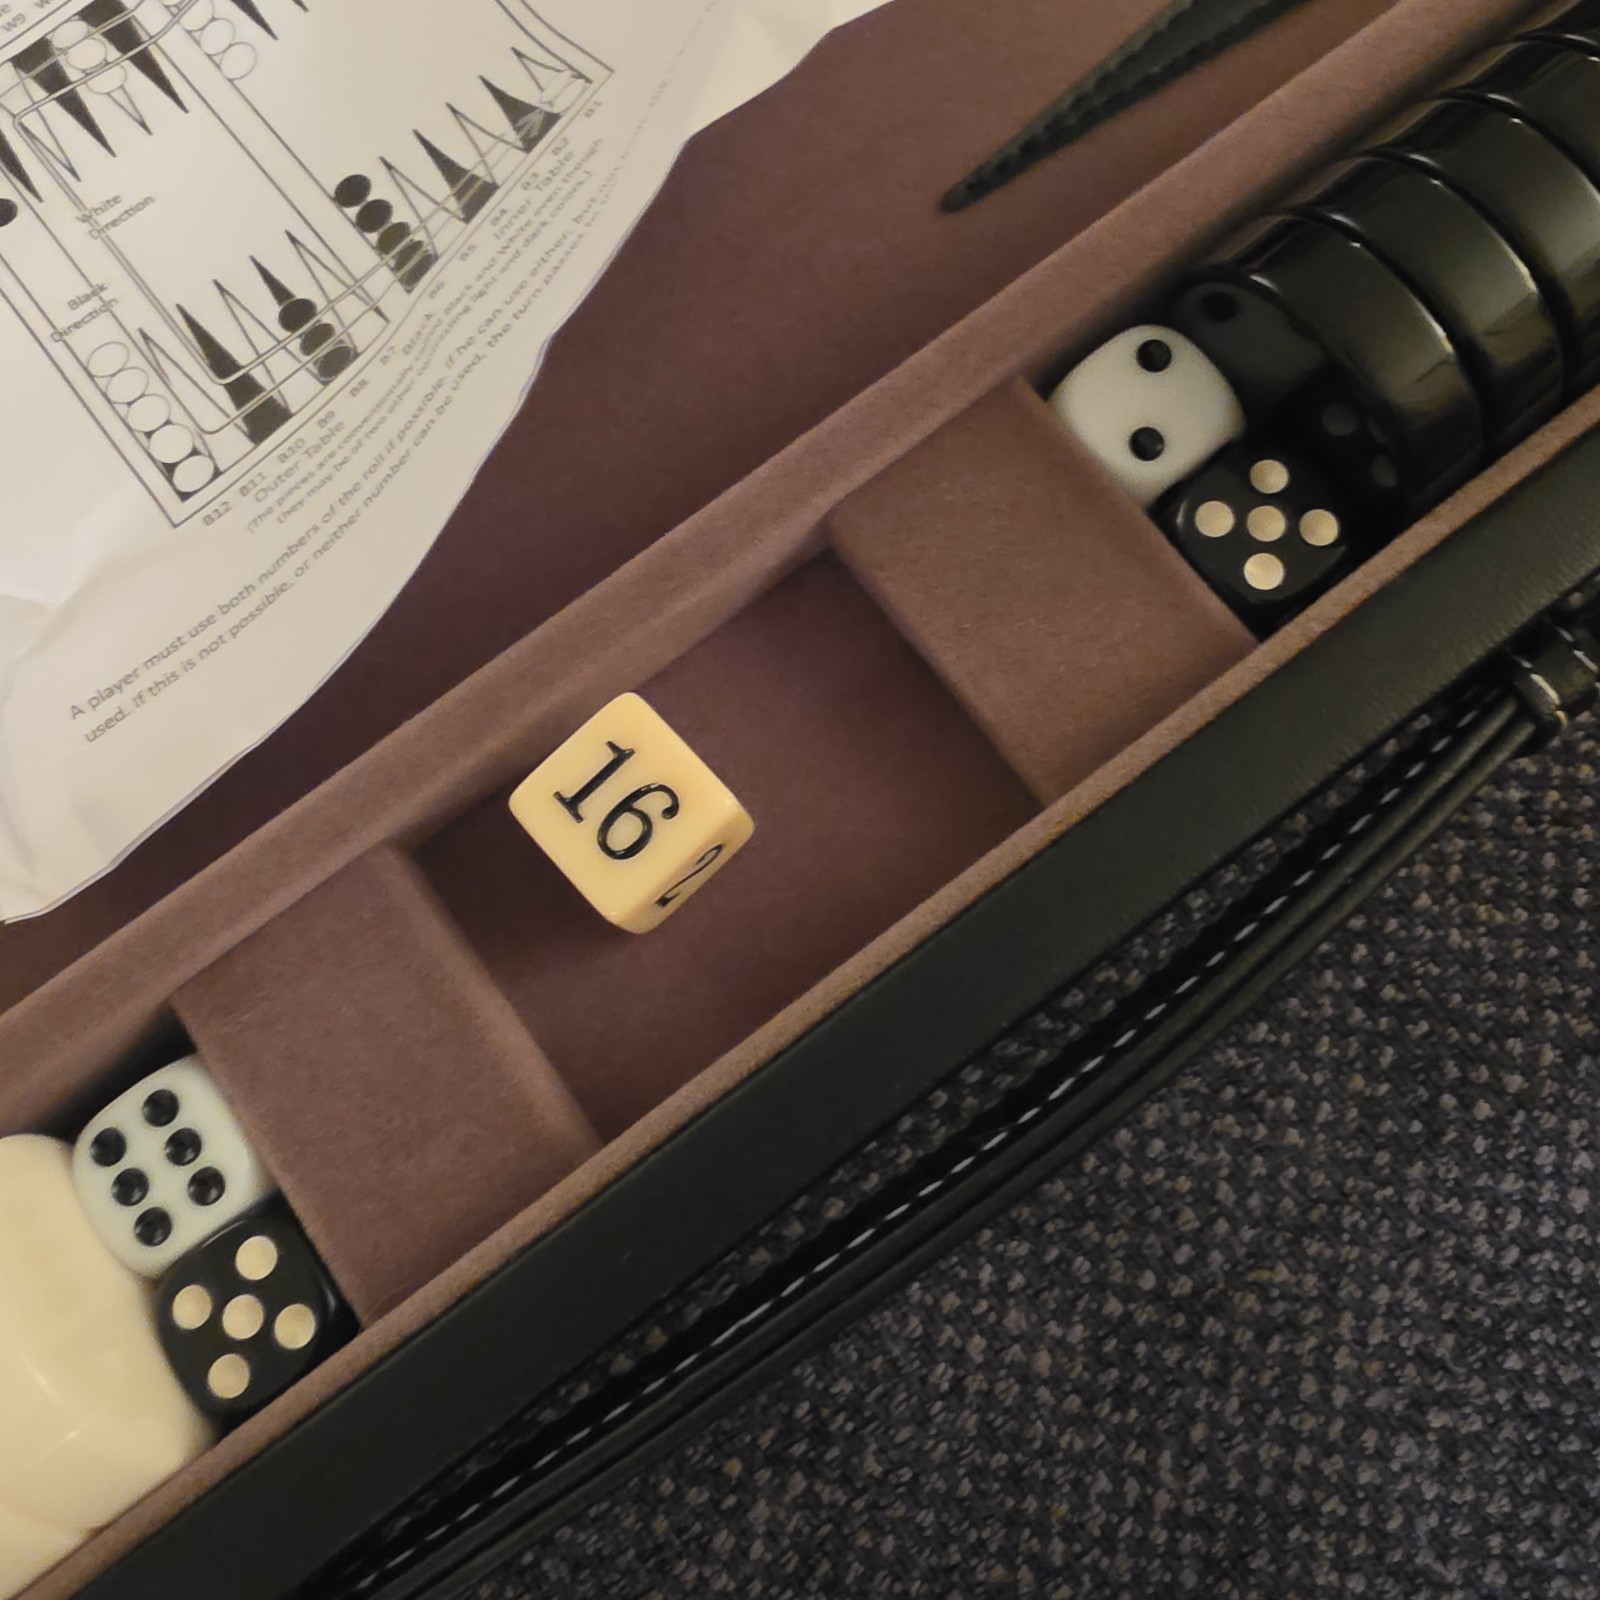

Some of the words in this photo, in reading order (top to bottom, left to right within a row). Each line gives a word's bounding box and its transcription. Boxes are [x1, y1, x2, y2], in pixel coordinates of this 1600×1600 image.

[76, 193, 123, 225] White
[89, 194, 156, 240] Direction
[494, 199, 533, 241] Inner
[534, 151, 575, 192] Table
[51, 296, 120, 344] Direction
[67, 281, 109, 312] Black
[276, 470, 315, 507] pieces
[317, 451, 337, 470] are
[475, 257, 498, 282] and
[497, 219, 533, 255] White
[534, 186, 563, 217] even
[561, 138, 603, 184] though
[402, 312, 436, 356] Black
[277, 499, 305, 524] they
[306, 474, 333, 498] may
[333, 455, 351, 473] be
[352, 439, 364, 454] of
[364, 416, 387, 439] two
[387, 378, 415, 414] other
[500, 249, 522, 275] and
[522, 220, 549, 249] dark
[70, 705, 85, 720] A
[87, 667, 141, 712] player
[142, 636, 187, 670] must
[187, 614, 217, 639] use
[217, 584, 256, 615] both
[258, 523, 321, 584] numbers
[321, 504, 338, 524] of
[337, 482, 362, 506] the
[362, 453, 387, 480] roll
[386, 439, 397, 454] if
[455, 335, 477, 356] he
[477, 308, 503, 335] can
[503, 279, 528, 306] use
[571, 197, 598, 225] but
[202, 500, 232, 526] B12
[239, 471, 267, 497] B11
[277, 438, 305, 464] B10
[317, 410, 336, 429] B9
[255, 460, 301, 502] Outer
[303, 420, 345, 459] Table
[84, 706, 132, 743] used.
[133, 691, 147, 708] If
[148, 670, 180, 697] this
[180, 658, 196, 672] is
[198, 634, 227, 660] not
[294, 559, 310, 578] or
[313, 508, 361, 560] neither
[363, 448, 411, 508] number
[413, 418, 436, 447] can
[435, 395, 453, 416] be
[486, 323, 512, 348] the
[512, 288, 542, 321] turn
[553, 741, 679, 860] 16
[655, 844, 723, 907] 2
